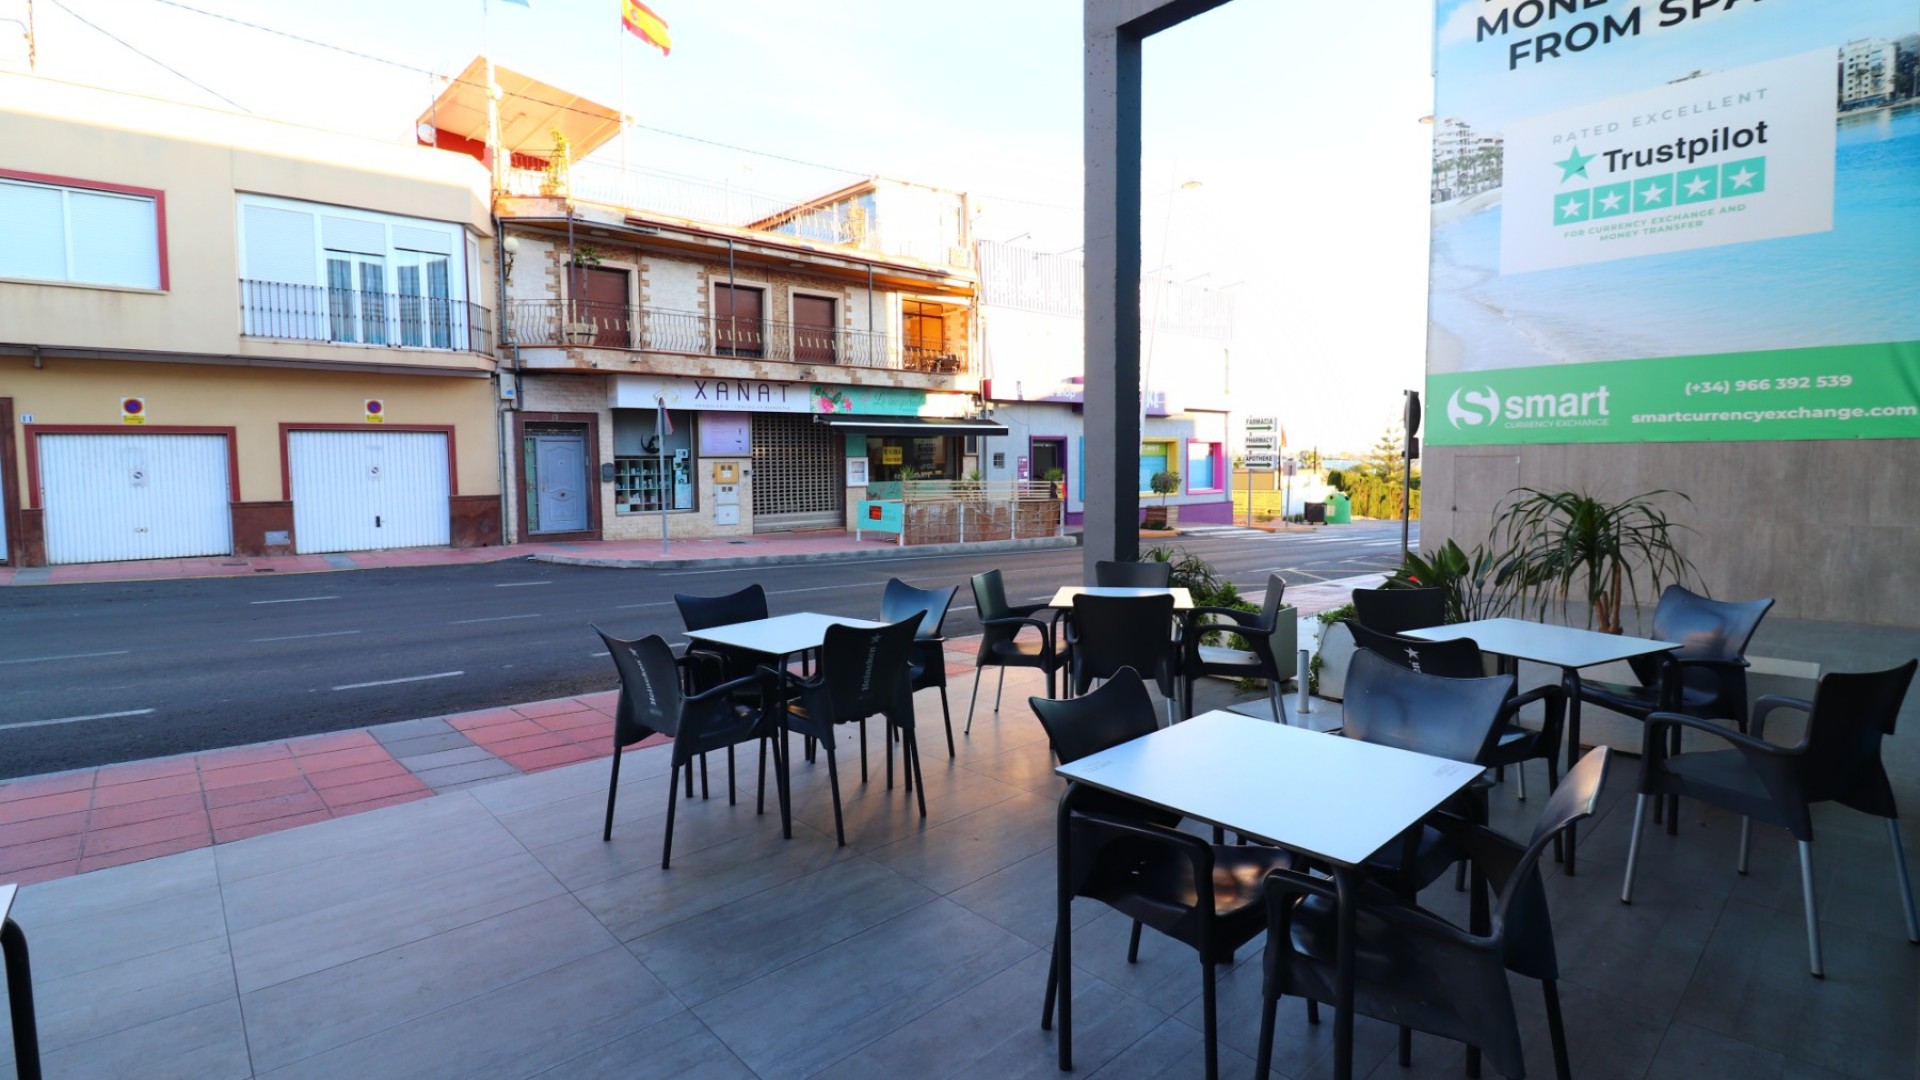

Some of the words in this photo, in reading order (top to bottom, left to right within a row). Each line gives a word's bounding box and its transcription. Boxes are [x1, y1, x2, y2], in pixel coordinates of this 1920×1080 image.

[1509, 6, 1641, 71] FROM
[1552, 122, 1619, 145] RATED
[1632, 88, 1768, 127] EXCELLENT
[1602, 121, 1768, 173] Trustpilot
[1564, 230, 1585, 239] FOR
[1588, 219, 1648, 235] CURRENCY
[1651, 209, 1715, 225] EXCHANGE
[1719, 204, 1746, 215] AND
[1599, 231, 1640, 241] MONEY
[1643, 220, 1704, 235] TRANSFER
[694, 380, 790, 403] XANAT
[1504, 385, 1610, 420] smart
[1685, 380, 1730, 396] (+34)
[1735, 379, 1771, 391] 966
[1775, 377, 1811, 390] 392
[1816, 375, 1853, 388] 539
[1504, 420, 1553, 429] CURRENCY
[1555, 418, 1610, 428] EXCHANGE
[1631, 405, 1918, 423] smartcurrencyexchange.com
[862, 646, 877, 692] Heineken
